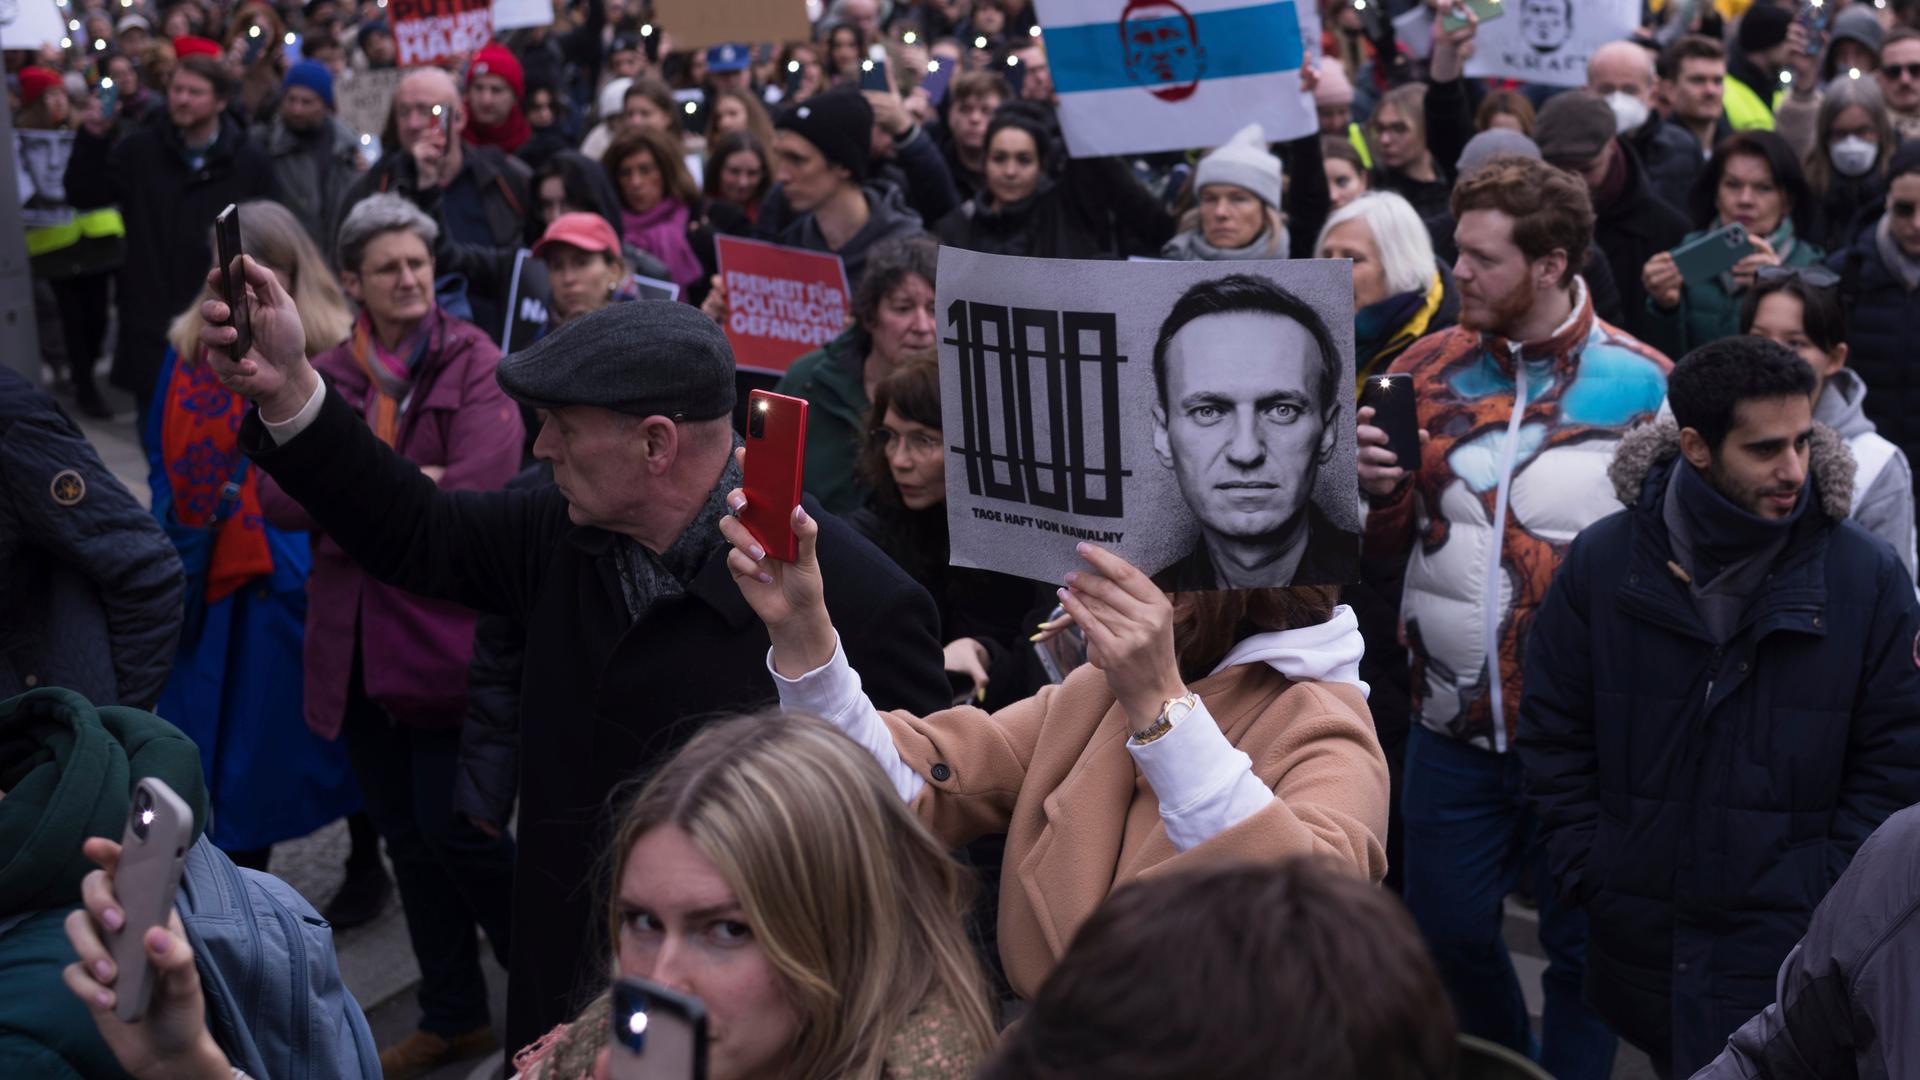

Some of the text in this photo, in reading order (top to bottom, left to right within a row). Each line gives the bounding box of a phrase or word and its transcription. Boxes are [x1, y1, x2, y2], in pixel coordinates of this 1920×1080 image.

[727, 271, 842, 305] FREIHEIT FÜR
[729, 291, 844, 328] POLITISCHE
[946, 299, 1125, 518] 1000
[971, 507, 1124, 543] TAGE HAFT VON NAWALNY
